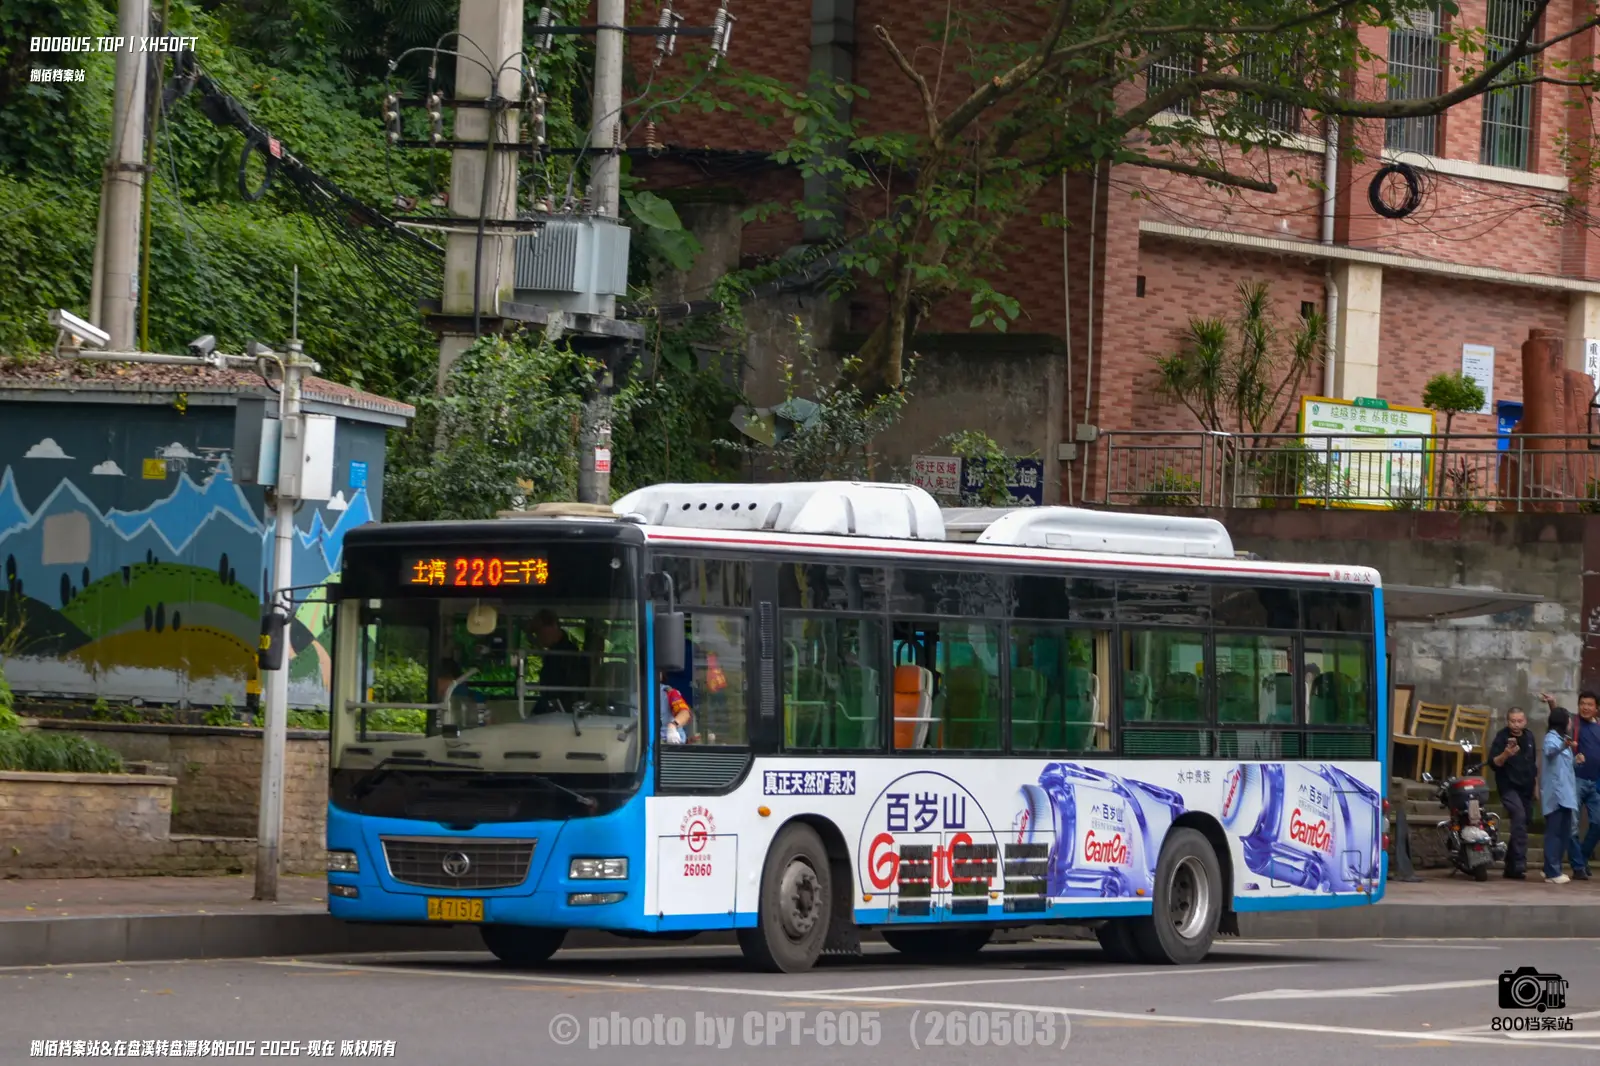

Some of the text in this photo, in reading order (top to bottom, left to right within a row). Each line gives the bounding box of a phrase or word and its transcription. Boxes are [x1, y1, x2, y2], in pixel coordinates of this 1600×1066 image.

[915, 462, 956, 474] 拆迁区域
[967, 465, 1037, 488] 拆区域
[411, 559, 447, 585] 土湾
[454, 558, 502, 586] 220
[764, 772, 855, 795] 真正天然矿泉水
[1177, 770, 1211, 784] 水中贵族
[886, 792, 966, 833] 百岁山
[1102, 803, 1124, 823] 百岁山
[1289, 808, 1332, 852] Ganten
[1084, 830, 1127, 864] Ganten
[683, 863, 713, 877] 26060
